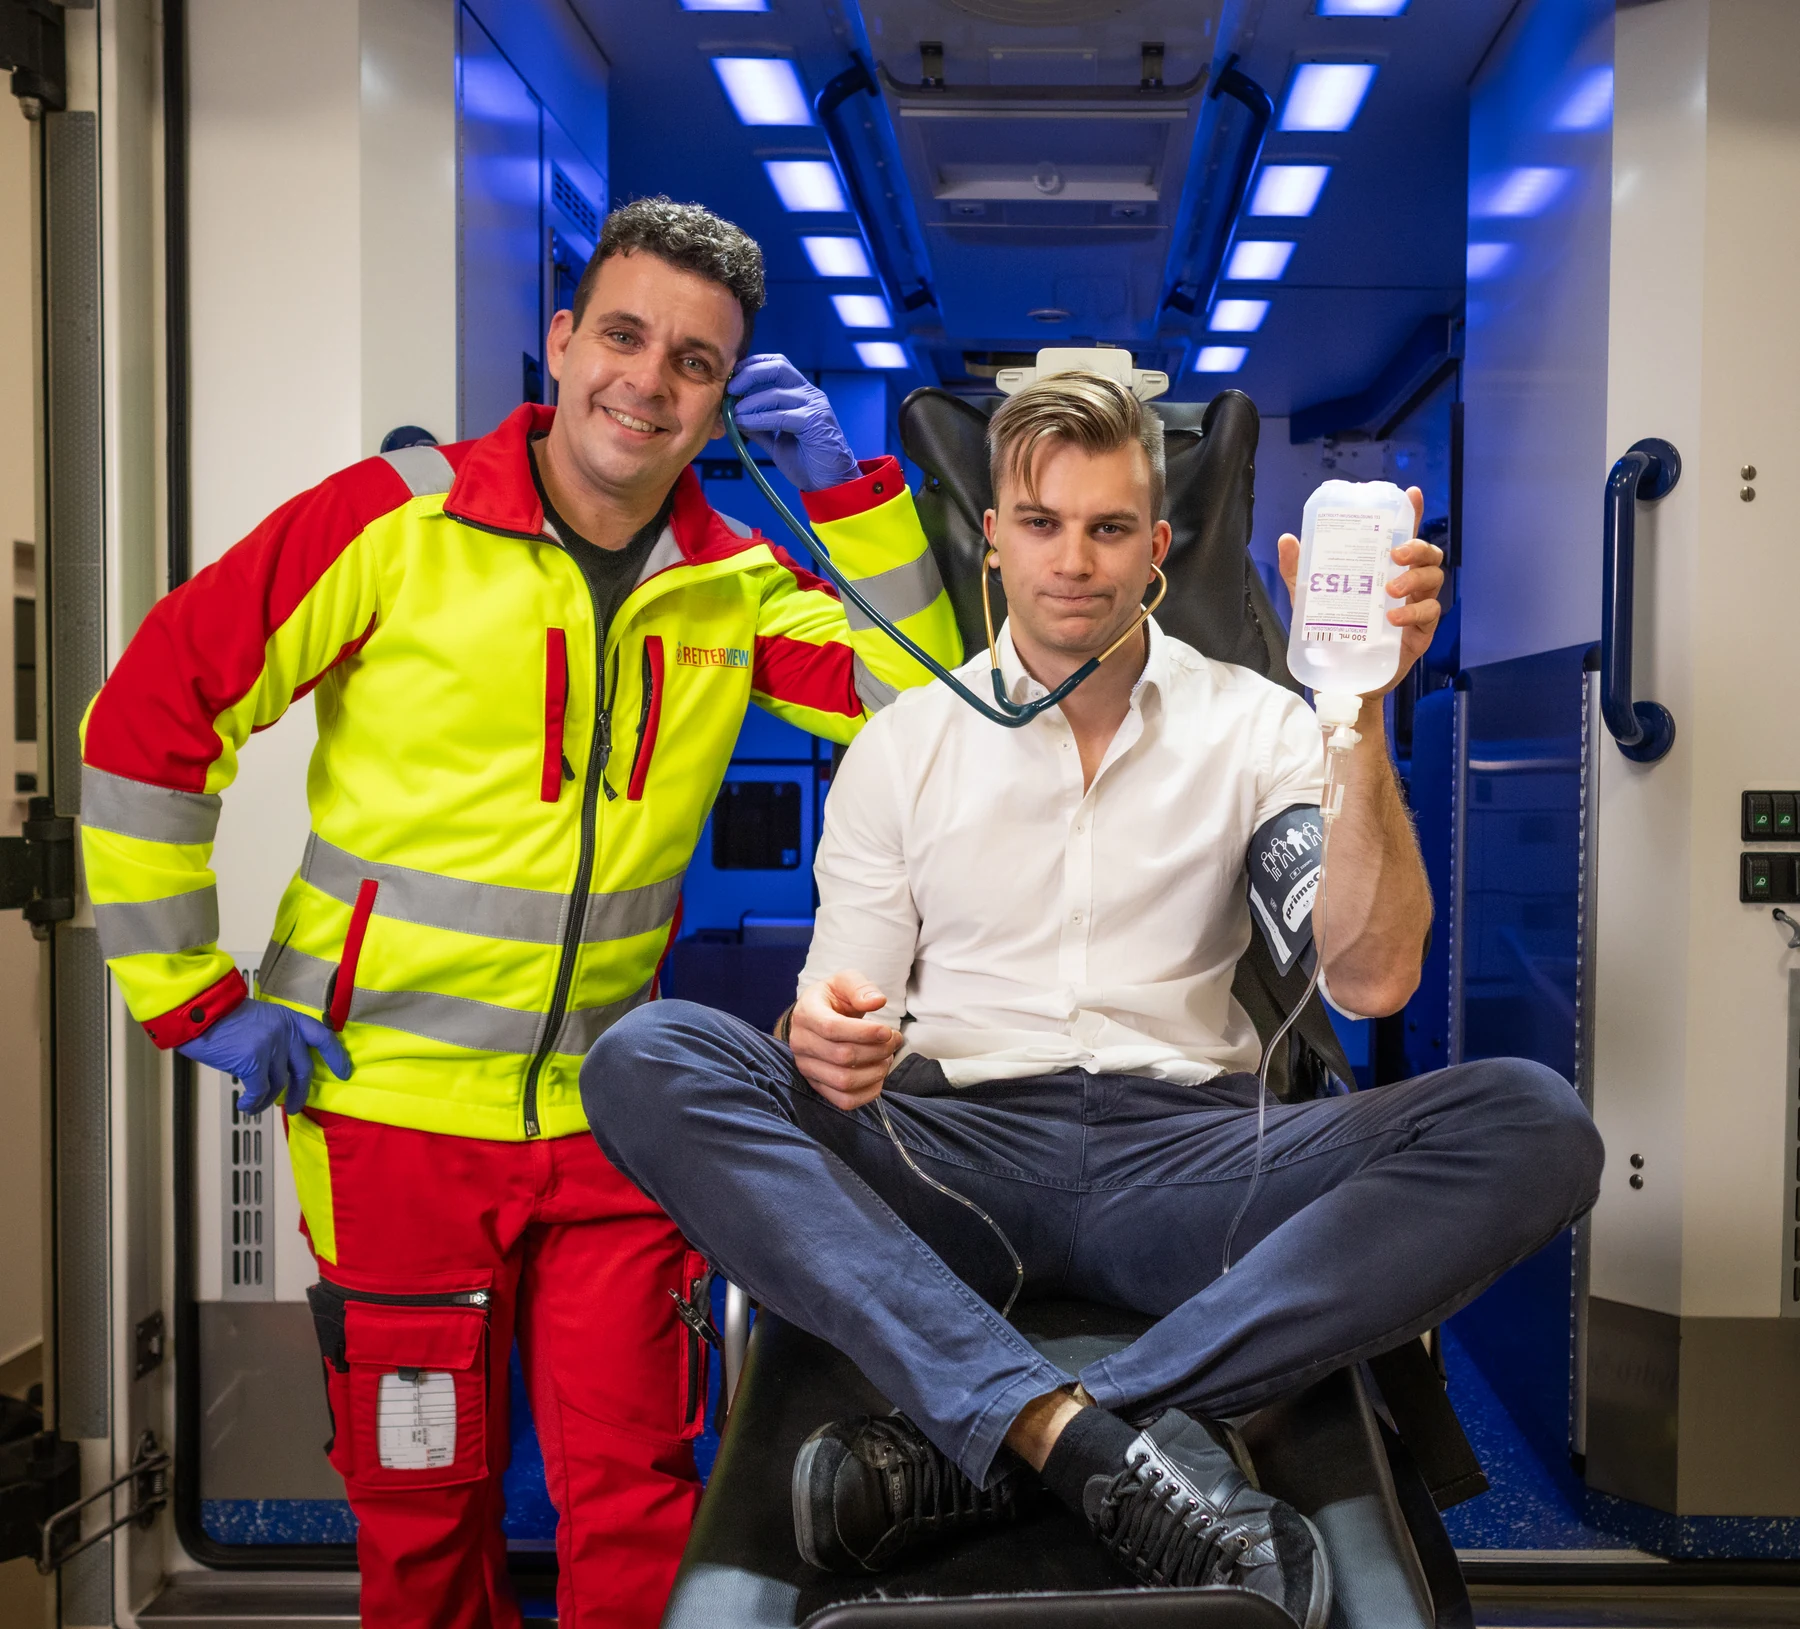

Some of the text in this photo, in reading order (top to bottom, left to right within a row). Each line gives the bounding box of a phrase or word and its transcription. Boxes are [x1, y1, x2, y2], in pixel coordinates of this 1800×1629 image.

[1310, 573, 1352, 593] 153
[1359, 575, 1373, 594] E
[1351, 633, 1367, 641] 500
[683, 646, 749, 666] RETTERVIEW
[893, 1477, 901, 1500] BOSS
